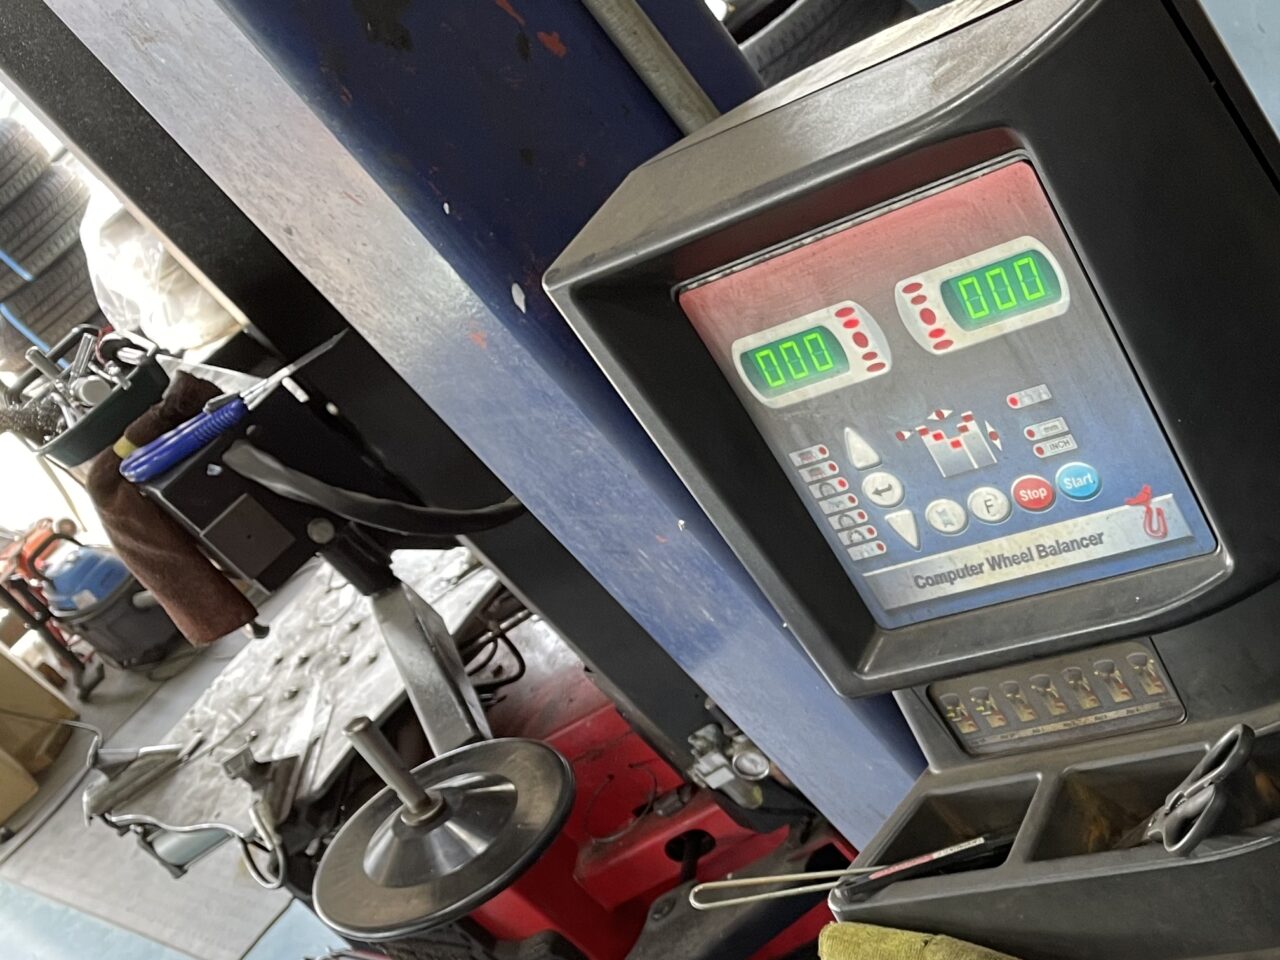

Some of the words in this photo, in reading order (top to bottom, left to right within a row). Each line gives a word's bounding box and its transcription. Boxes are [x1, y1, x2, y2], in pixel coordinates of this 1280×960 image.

[957, 256, 1046, 320] 000
[755, 332, 833, 388] 000
[1049, 439, 1071, 451] INCH
[1063, 473, 1093, 490] Start
[1018, 486, 1048, 503] Stop
[983, 498, 995, 514] F
[914, 561, 985, 590] Computer
[986, 547, 1034, 572] Wheel
[1037, 531, 1104, 559] Balancer
